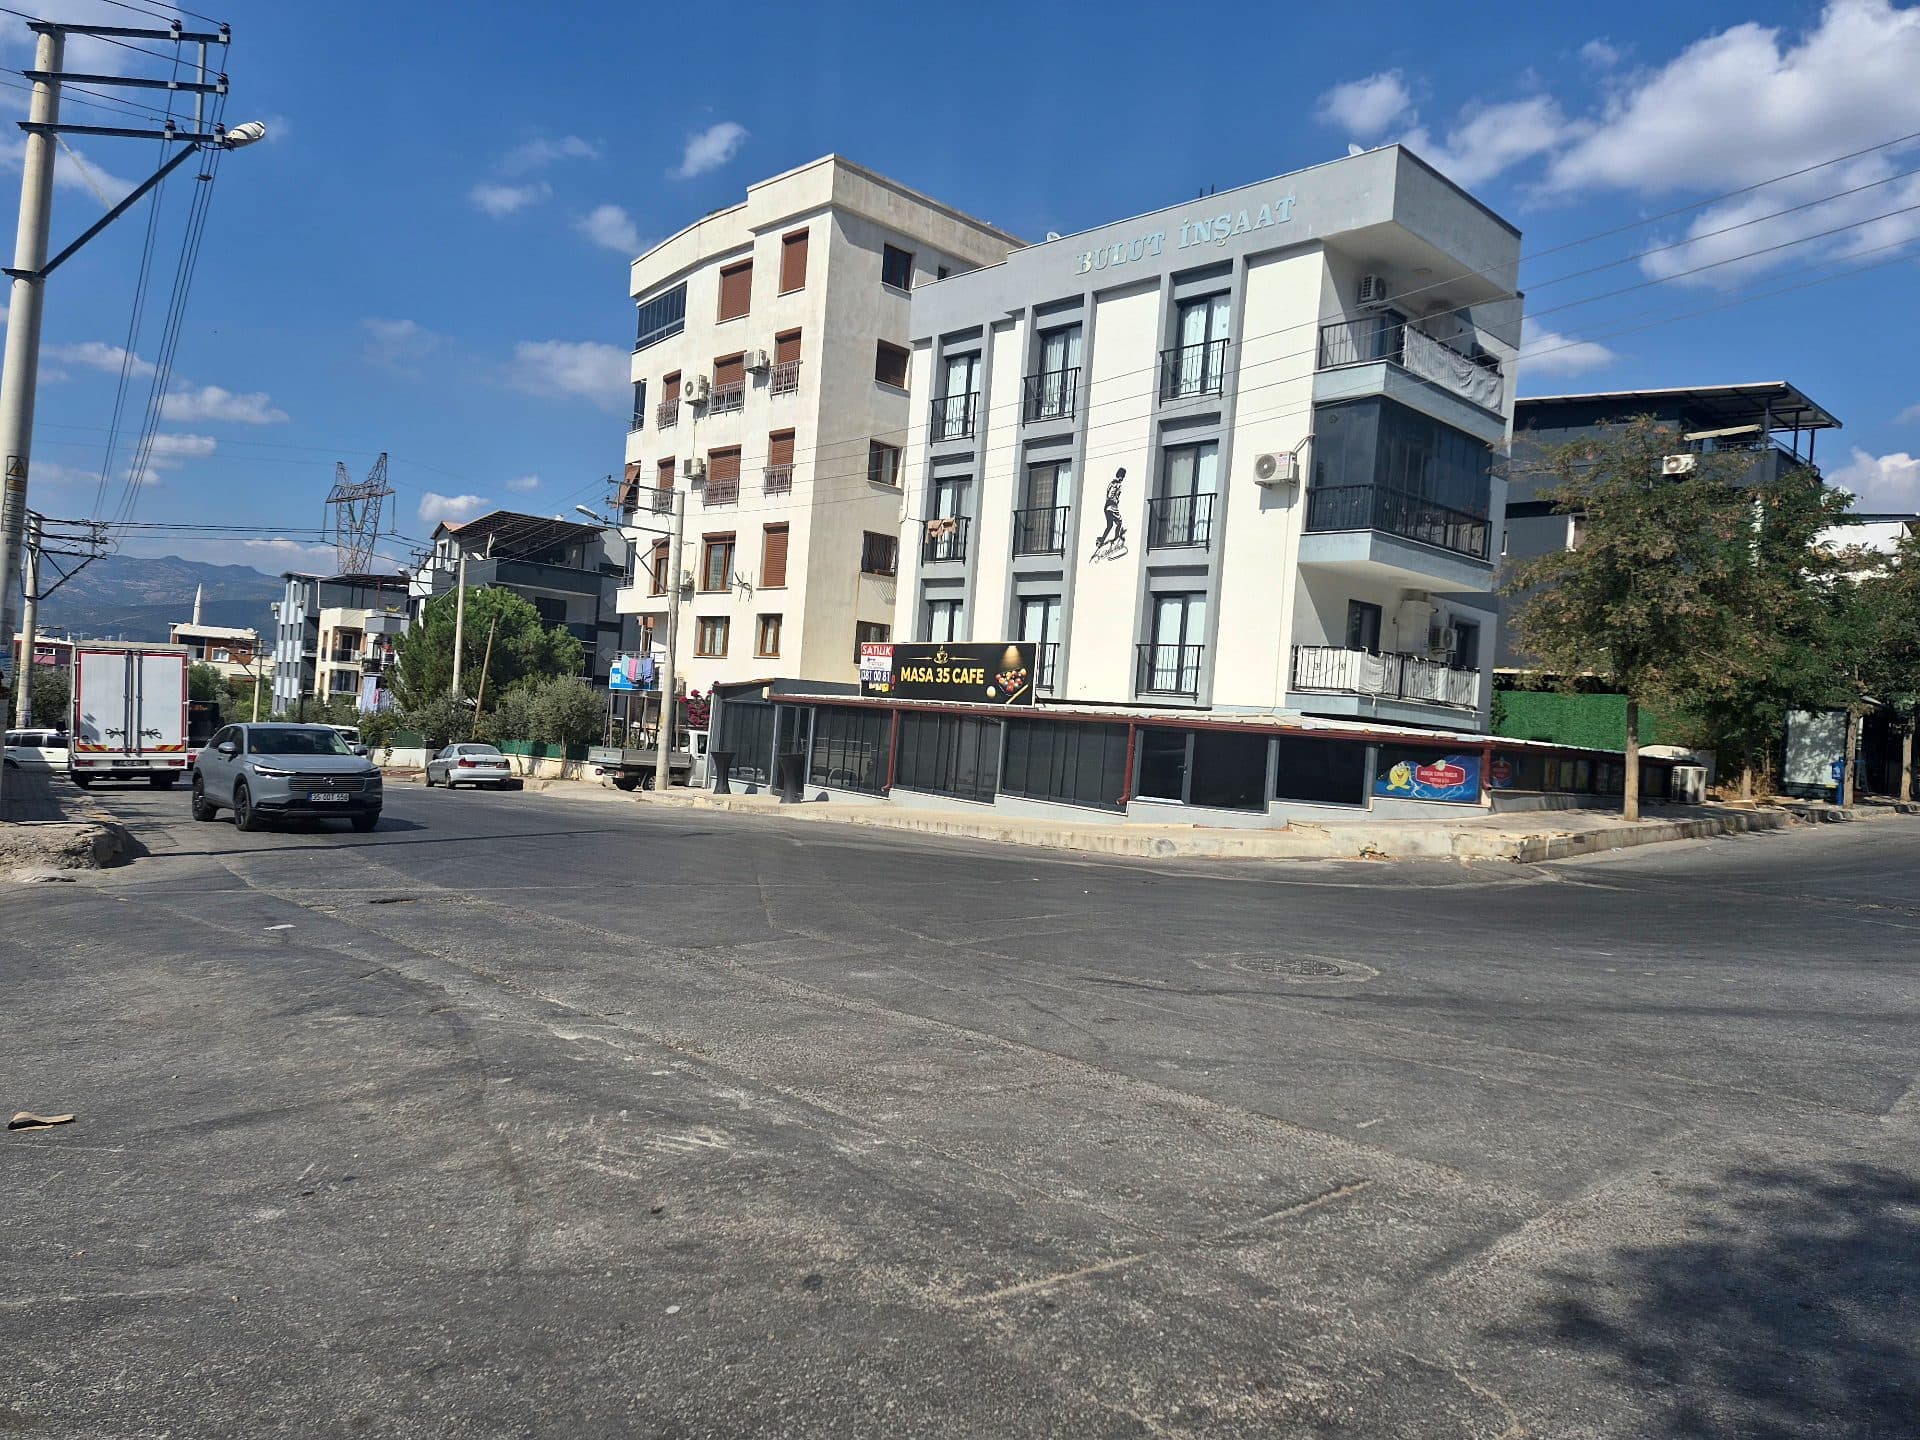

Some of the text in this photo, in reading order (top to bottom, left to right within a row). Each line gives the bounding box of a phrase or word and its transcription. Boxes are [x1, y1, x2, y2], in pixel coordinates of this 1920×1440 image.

[1075, 195, 1297, 275] BULUT İNŞAAT
[862, 645, 891, 656] SATILIK
[901, 666, 985, 684] MASA 35 CAFE
